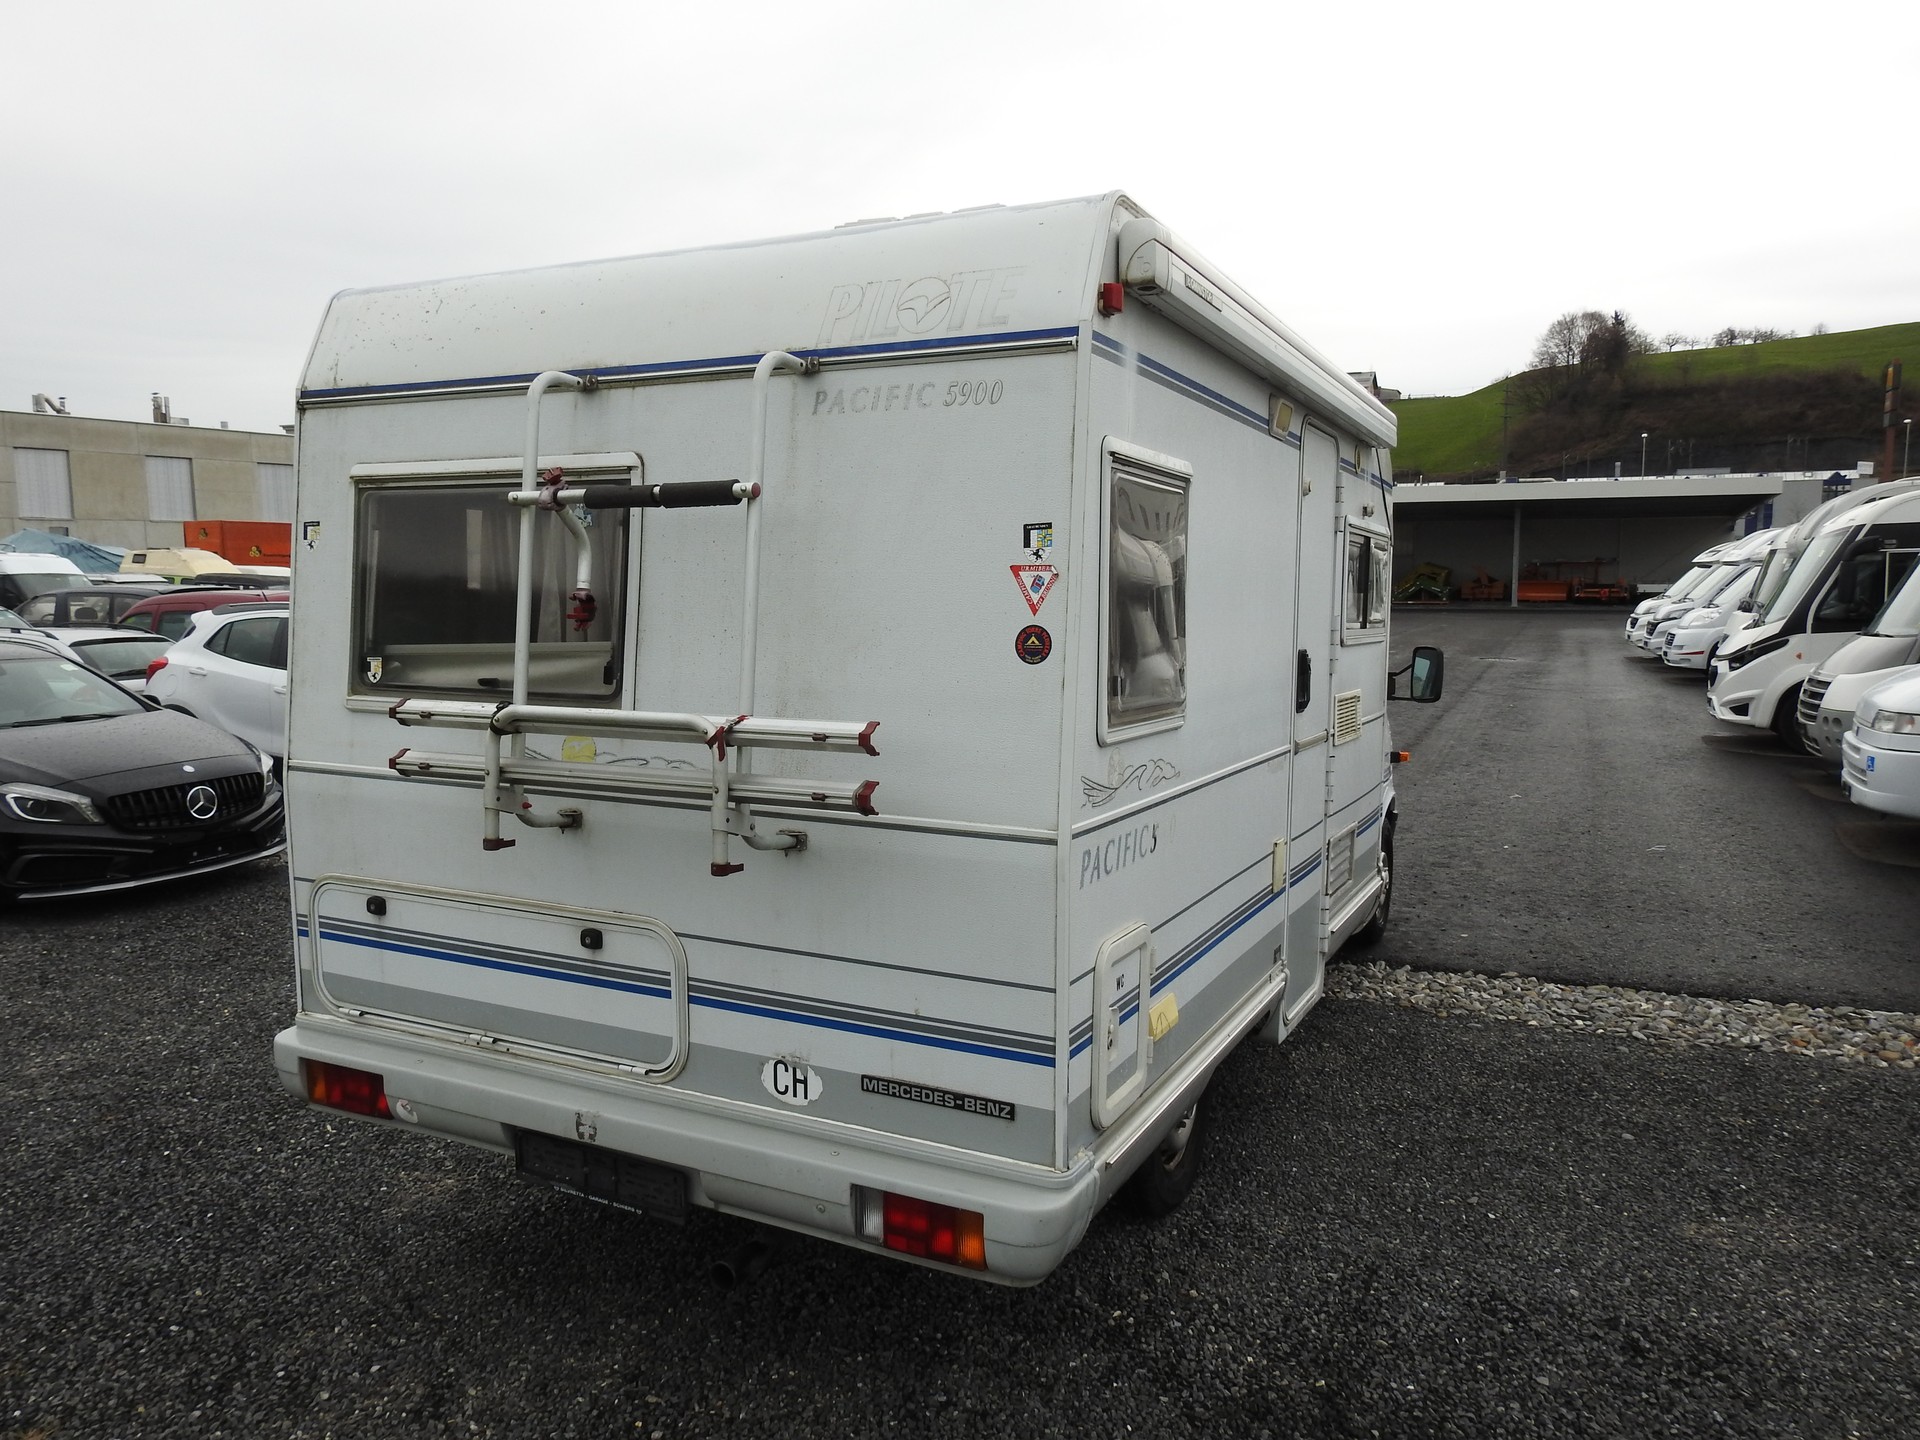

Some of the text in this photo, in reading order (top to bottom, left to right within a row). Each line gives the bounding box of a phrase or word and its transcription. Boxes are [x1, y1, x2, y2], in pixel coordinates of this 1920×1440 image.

[812, 379, 1004, 415] PACIFIC 5900
[1080, 825, 1149, 890] PACIFIC
[1116, 973, 1125, 991] WC
[773, 1059, 808, 1100] CH
[862, 1077, 1012, 1119] MERCEDES-BENZ
